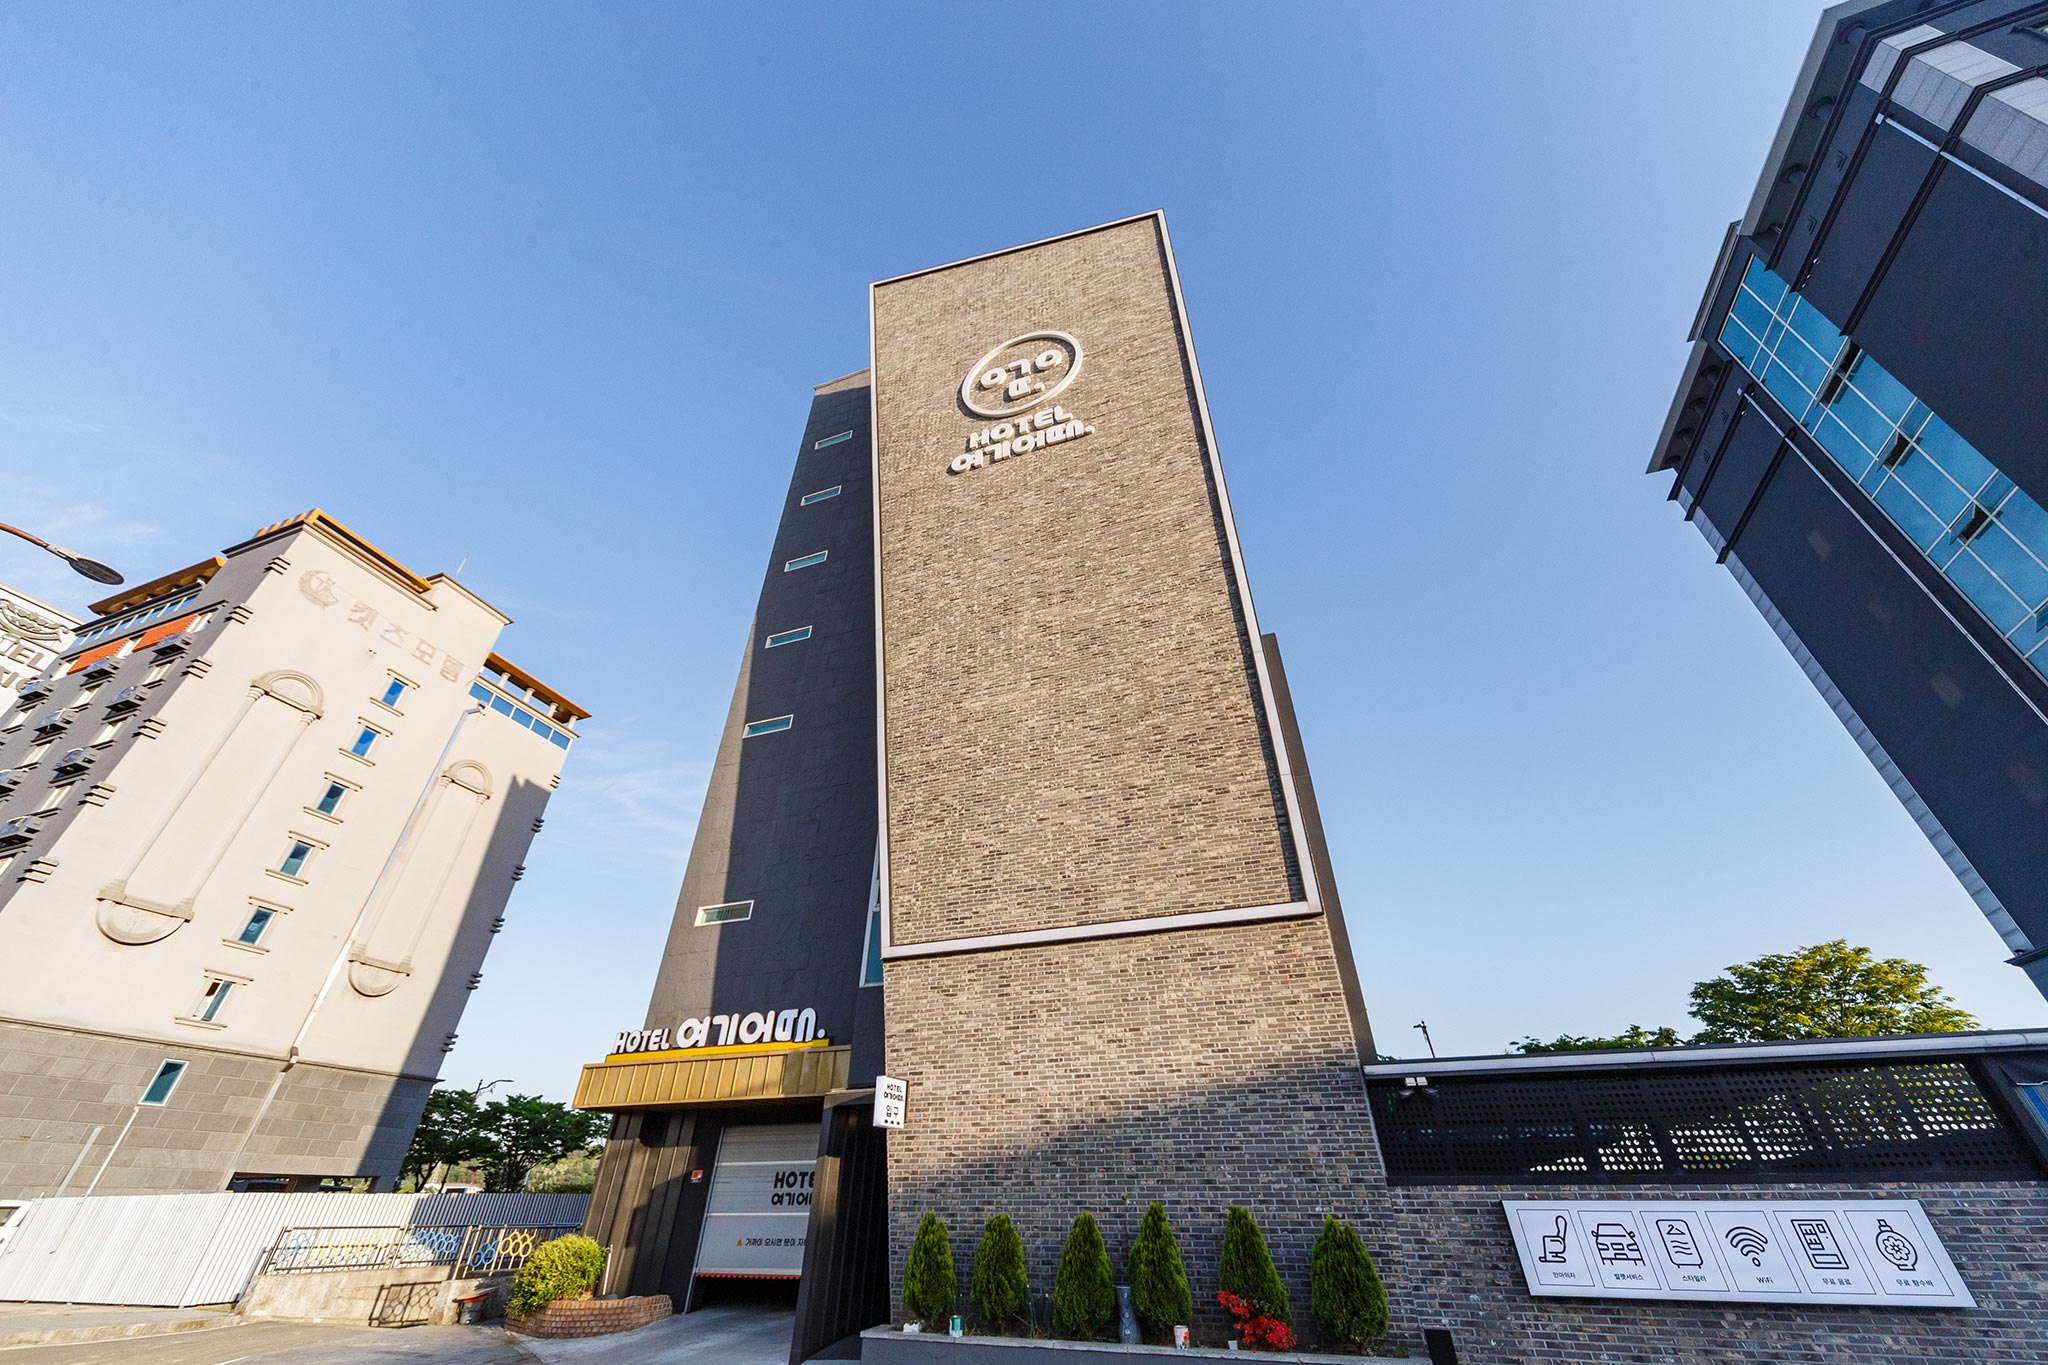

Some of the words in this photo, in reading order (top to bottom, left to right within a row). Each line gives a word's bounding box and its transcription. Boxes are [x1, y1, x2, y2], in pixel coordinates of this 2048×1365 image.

[969, 405, 1074, 449] HOTEL
[611, 1028, 670, 1054] HOTEL
[886, 1084, 902, 1093] HOTEL
[886, 1105, 899, 1118] 입구
[773, 1171, 815, 1189] HOTE
[771, 1192, 813, 1206] 여기어
[1552, 1271, 1576, 1279] 안마의자
[1681, 1274, 1707, 1283] 스타일러
[1756, 1276, 1774, 1285] WiFi
[1821, 1277, 1836, 1286] 무료
[1896, 1278, 1911, 1287] 무료
